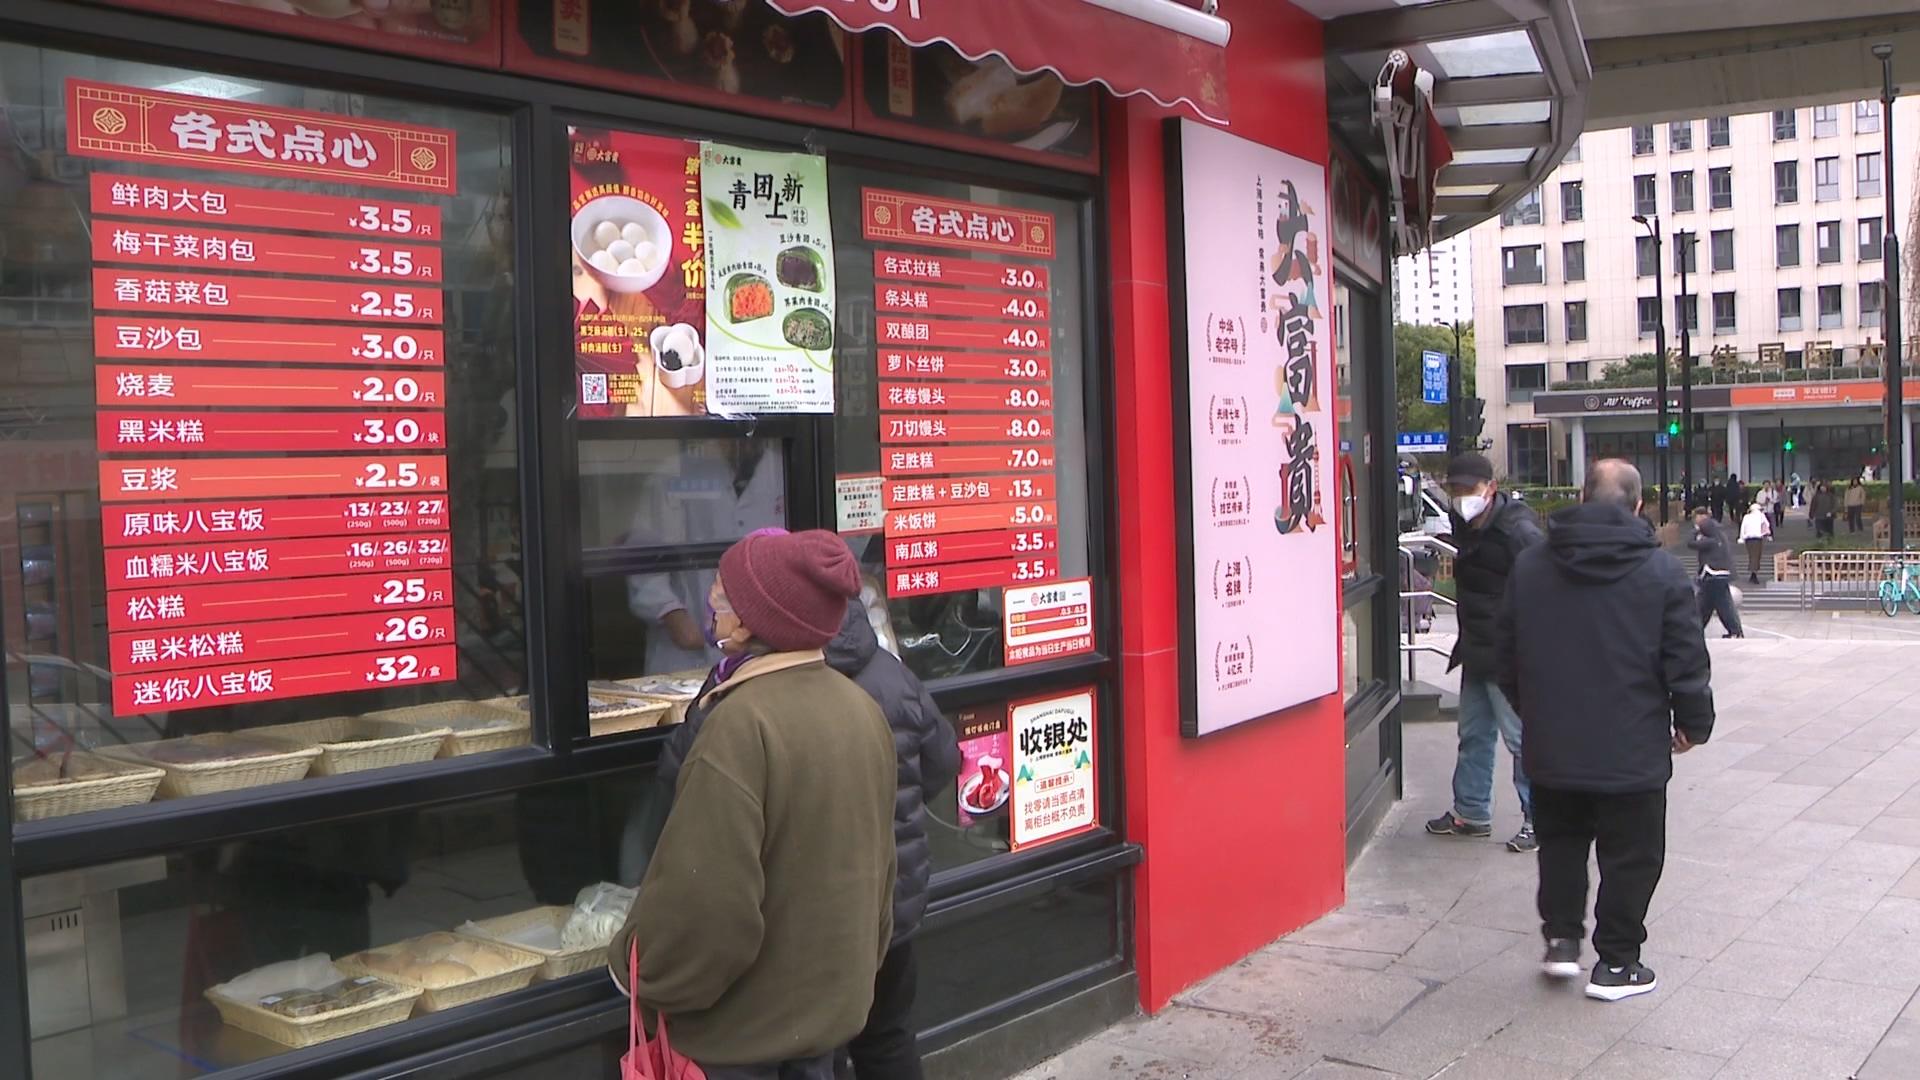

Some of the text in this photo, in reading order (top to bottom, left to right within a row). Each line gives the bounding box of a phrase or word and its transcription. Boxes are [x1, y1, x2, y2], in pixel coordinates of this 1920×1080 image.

[169, 111, 377, 170] 各式点心
[111, 182, 432, 235] 鲜肉大包 ¥3.5/只
[911, 205, 1015, 242] 各式点心
[112, 230, 433, 277] 梅干菜肉包 ¥3.5/只
[884, 257, 941, 278] 各式拉糕
[113, 278, 433, 319] 香菇菜包 ¥2.5/只
[885, 289, 929, 308] 条头糕
[886, 322, 929, 340] 双酿团
[1219, 318, 1234, 335] 中华
[115, 326, 434, 361] 豆沙包 ¥3.0/只
[1215, 337, 1239, 354] 老字号
[887, 354, 945, 373] 萝卜丝饼
[115, 373, 436, 403] 烧麦 ¥2.0/只
[888, 387, 945, 405] 花卷馒头
[1623, 396, 1653, 408] Coffee
[117, 419, 205, 443] 黑米糕
[889, 420, 946, 437] 刀切馒头
[891, 452, 934, 470] 定胜糕
[120, 467, 178, 491] 豆浆
[123, 506, 265, 537] 原味八宝饭
[894, 511, 936, 531] 米饭饼
[895, 541, 938, 561] 南瓜粥
[126, 548, 269, 579] 血糯米八宝饭
[1225, 561, 1241, 578] 上海
[896, 572, 939, 591] 黑米粥
[1226, 580, 1241, 596] 名牌
[127, 595, 185, 622] 松糕
[130, 631, 245, 663] 黑米松糕
[133, 669, 274, 706] 迷你八宝饭
[1019, 717, 1088, 756] 收银处
[1024, 788, 1085, 814] 找零请当面点清
